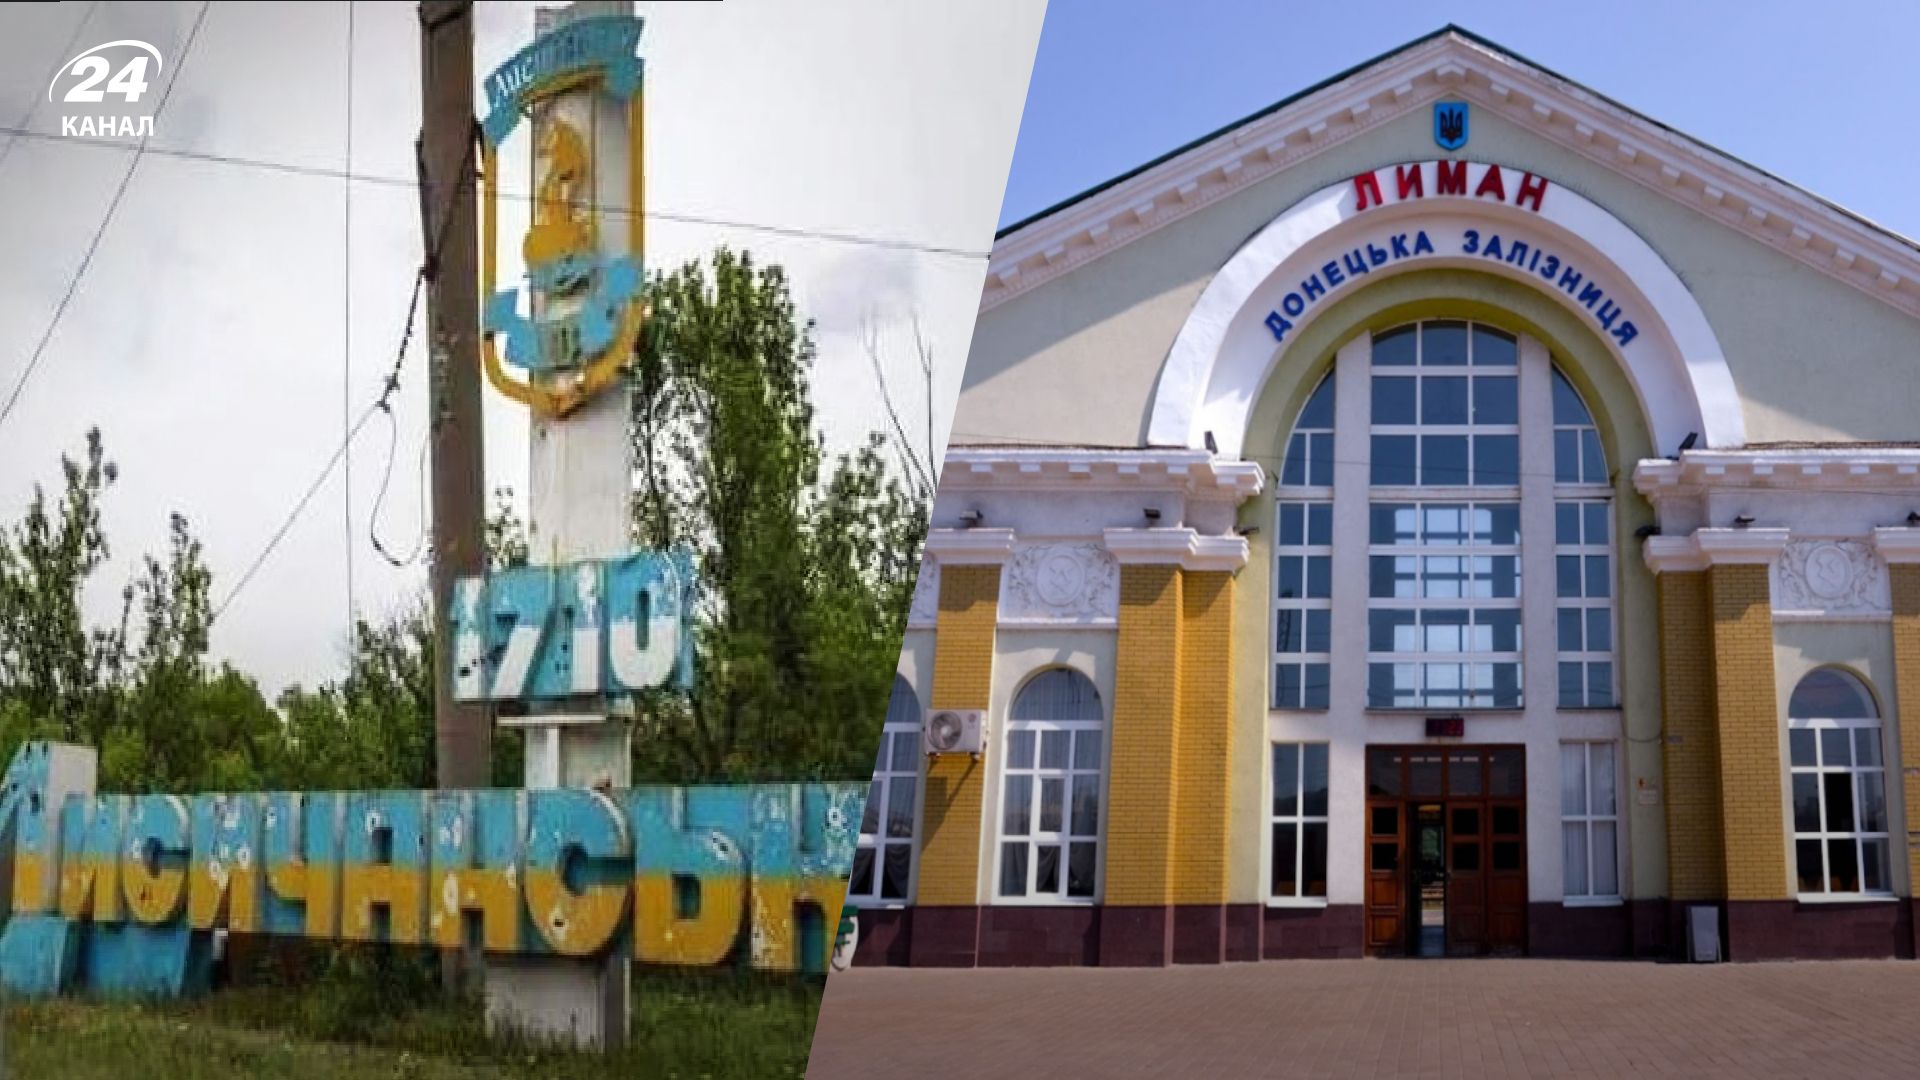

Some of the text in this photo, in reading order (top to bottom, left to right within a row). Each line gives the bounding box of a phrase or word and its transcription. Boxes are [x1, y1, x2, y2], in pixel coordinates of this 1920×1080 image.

[1353, 160, 1548, 212] ЛИМАН
[1264, 230, 1640, 347] ДОНЕЦЬКА ЗАЛІЗНИЦЯ
[452, 553, 681, 700] 1710
